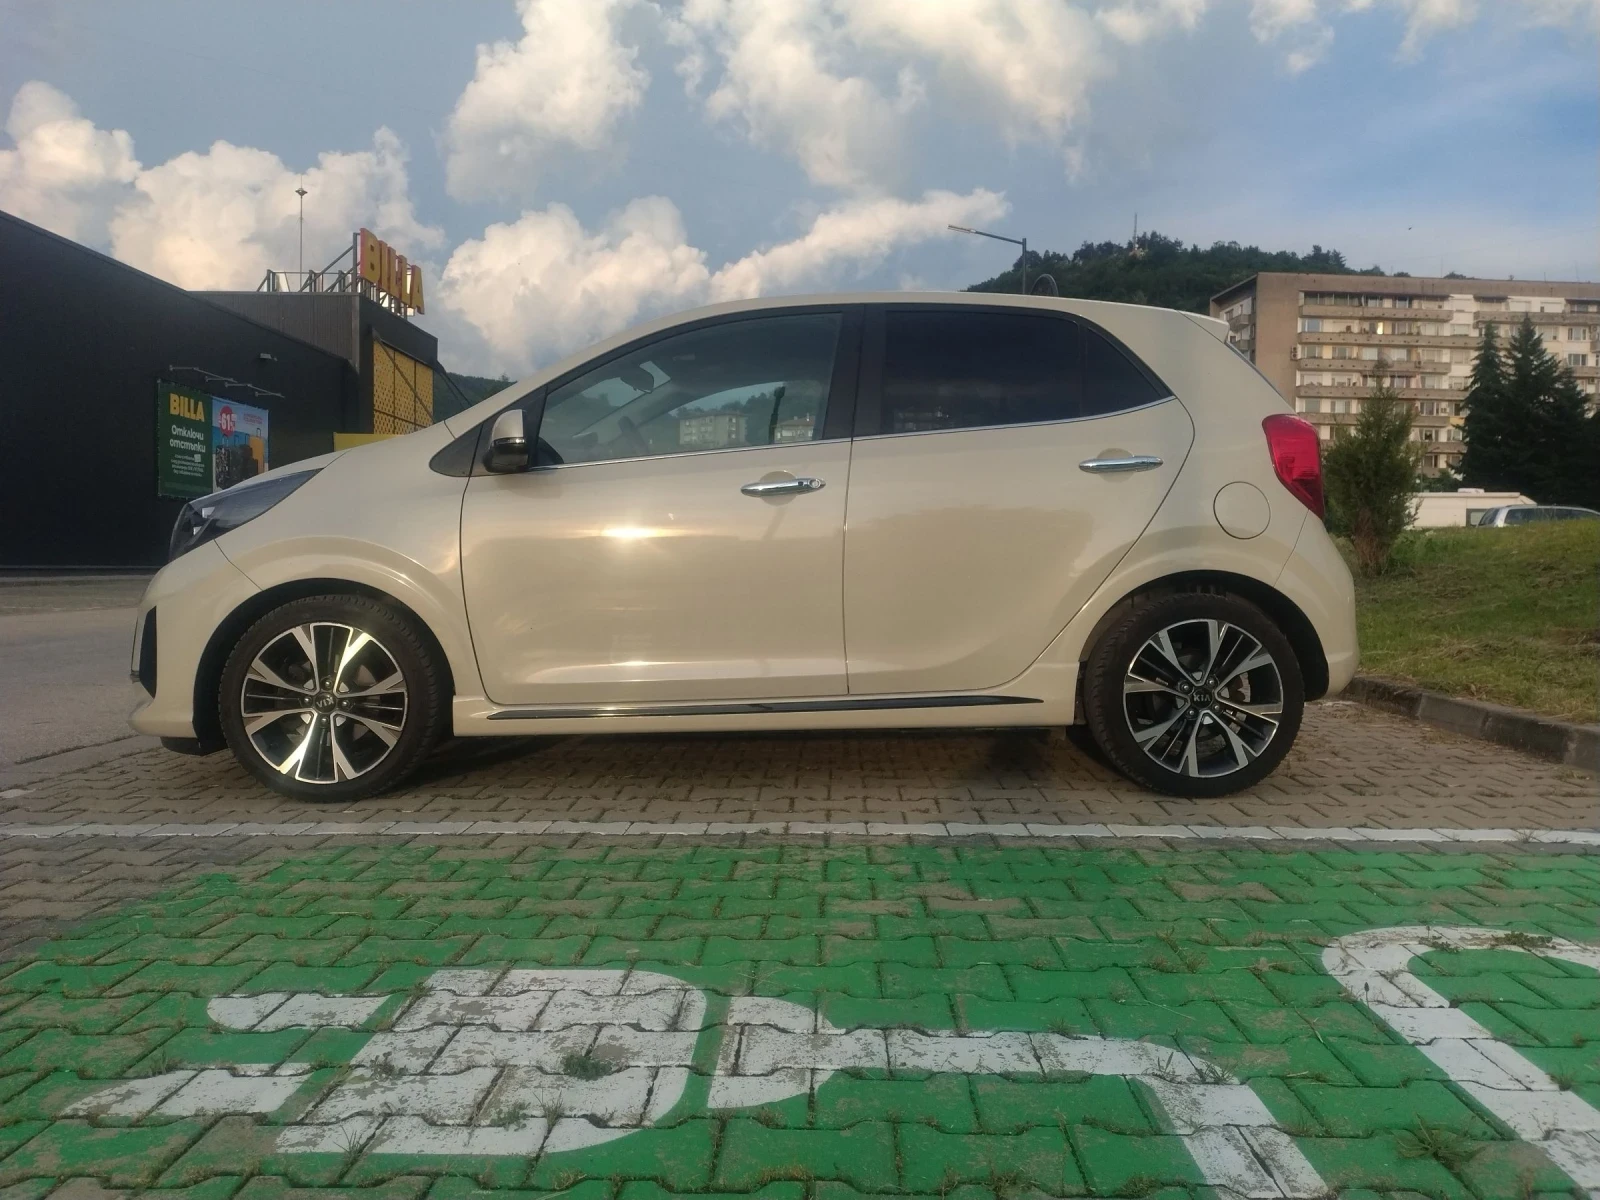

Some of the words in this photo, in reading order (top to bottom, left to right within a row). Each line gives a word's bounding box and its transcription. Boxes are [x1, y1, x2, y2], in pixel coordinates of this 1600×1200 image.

[360, 228, 425, 315] BILLA
[169, 393, 205, 422] BILLA
[316, 696, 334, 708] KIA
[1193, 694, 1211, 702] KIA
